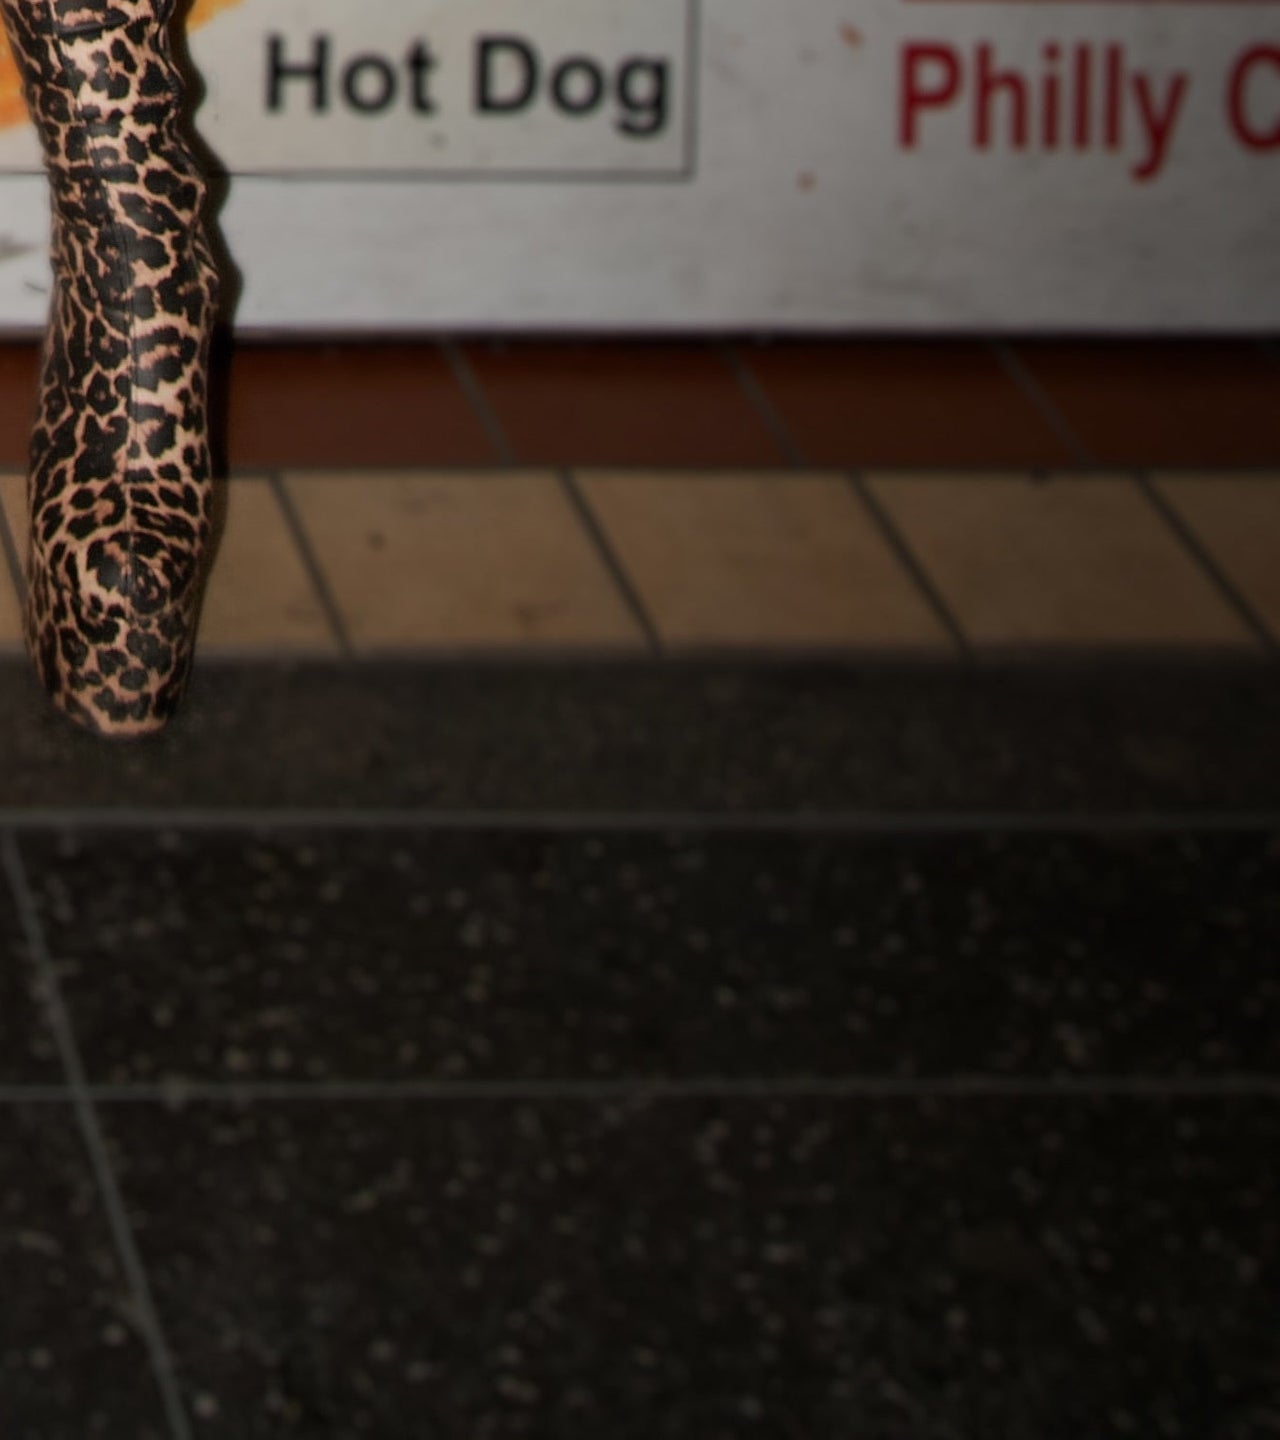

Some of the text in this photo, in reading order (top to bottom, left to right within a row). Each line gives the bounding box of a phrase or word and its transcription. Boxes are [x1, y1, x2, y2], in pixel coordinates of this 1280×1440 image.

[265, 32, 672, 139] Hot Dog
[897, 40, 1191, 184] Philly
